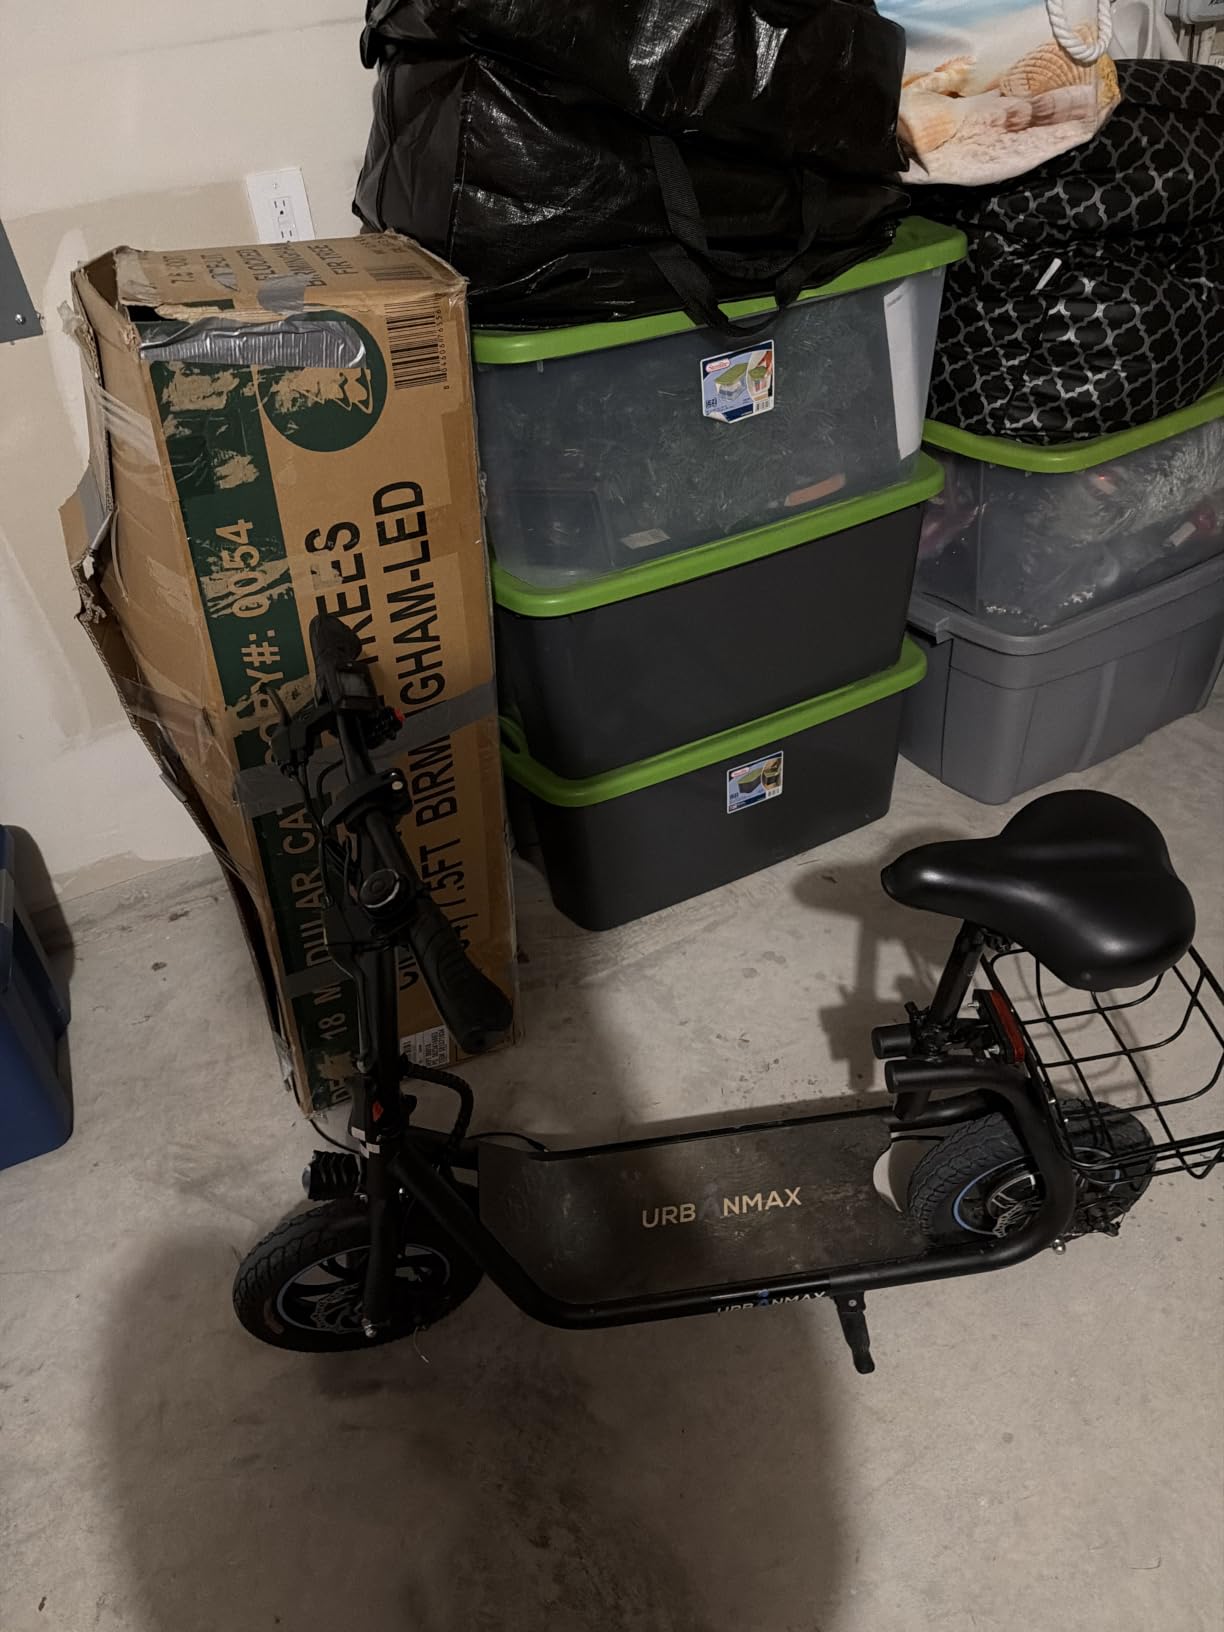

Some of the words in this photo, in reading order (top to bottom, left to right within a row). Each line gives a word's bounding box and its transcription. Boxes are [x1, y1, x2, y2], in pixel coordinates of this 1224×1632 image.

[308, 245, 342, 260] TREE
[328, 261, 358, 275] FIR
[305, 521, 378, 664] EES
[293, 864, 343, 1007] MDULAR
[317, 1011, 348, 1041] 18
